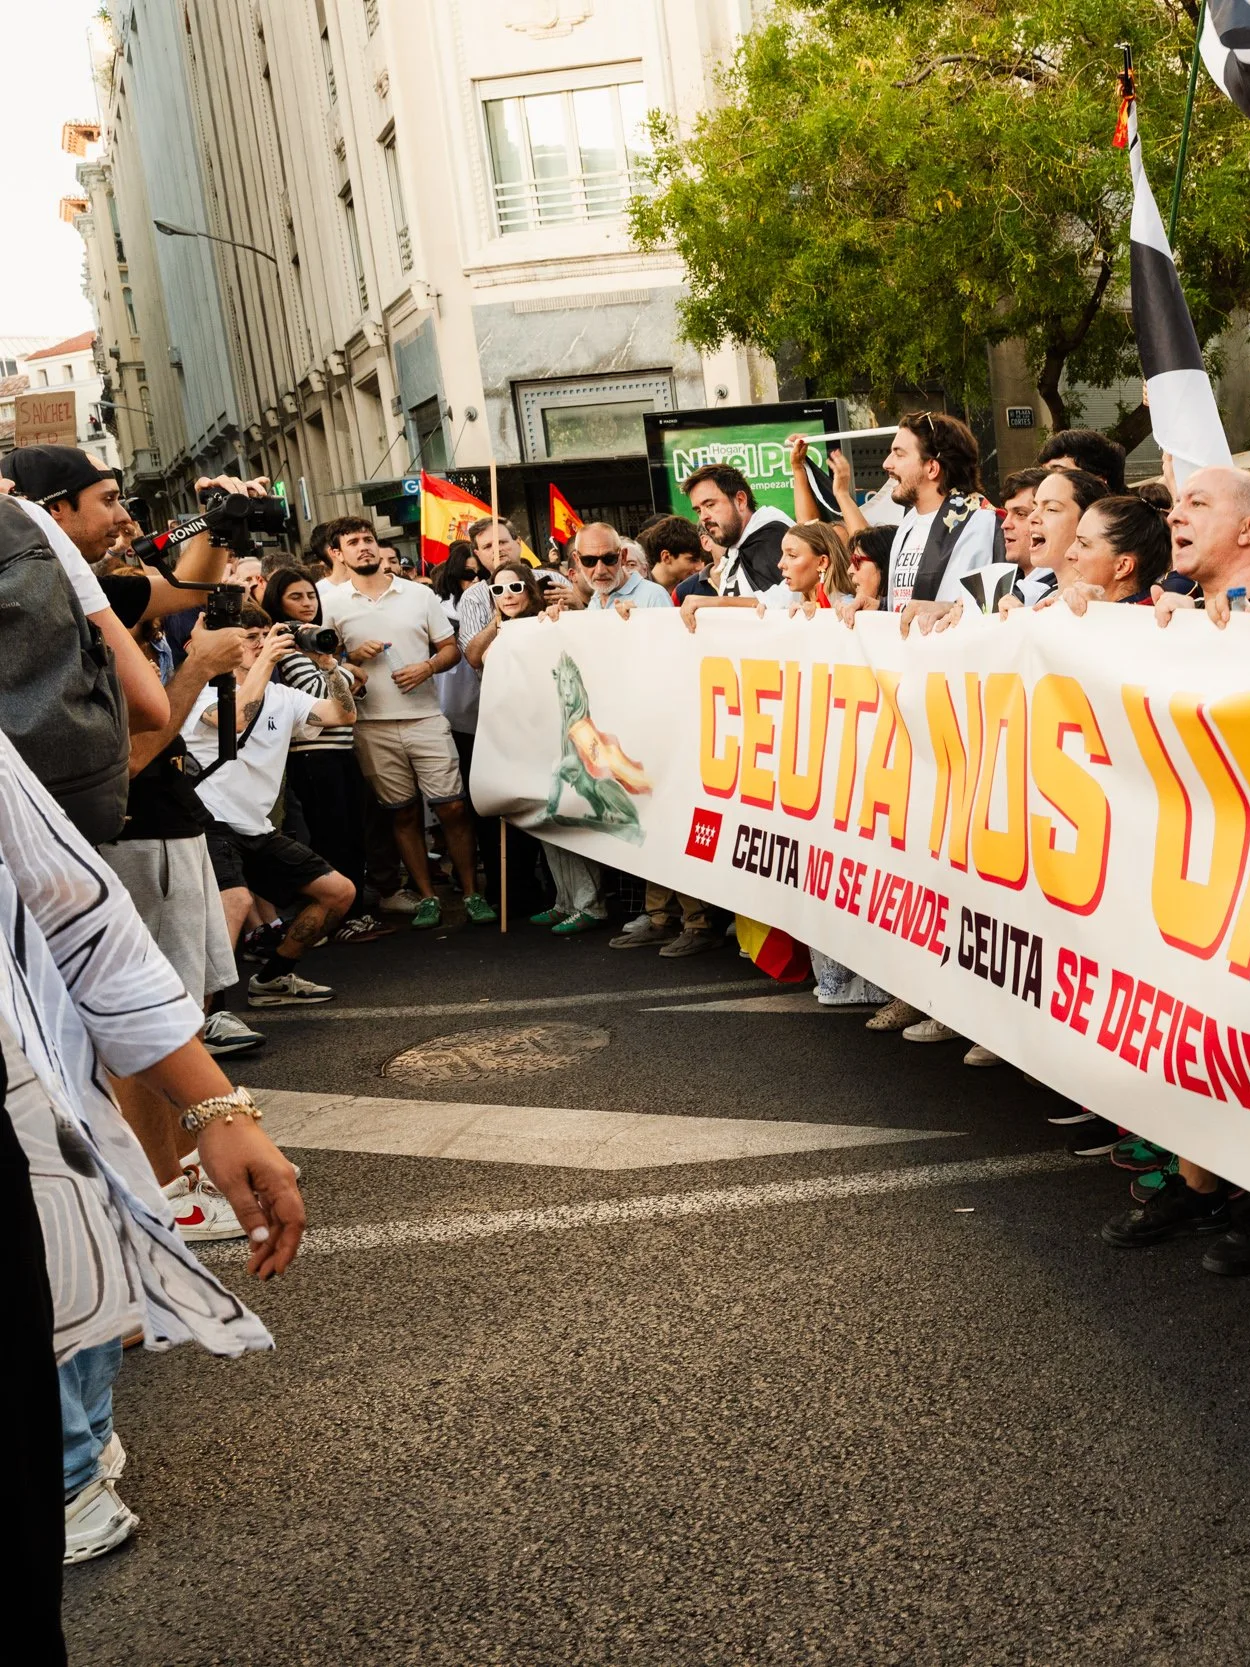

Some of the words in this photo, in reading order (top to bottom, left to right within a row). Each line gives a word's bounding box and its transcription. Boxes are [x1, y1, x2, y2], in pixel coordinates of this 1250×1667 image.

[712, 445, 742, 455] Hogar
[404, 480, 421, 494] G
[750, 481, 790, 492] empezar
[167, 518, 208, 544] RONIN
[700, 656, 912, 851] CEUTA
[925, 672, 1112, 916] NOS
[732, 824, 799, 888] CEUTA
[803, 845, 833, 902] NO
[834, 857, 867, 916] SE
[867, 872, 951, 968] VENDE,
[957, 905, 1043, 1009] CEUTA
[1050, 946, 1099, 1036] SE
